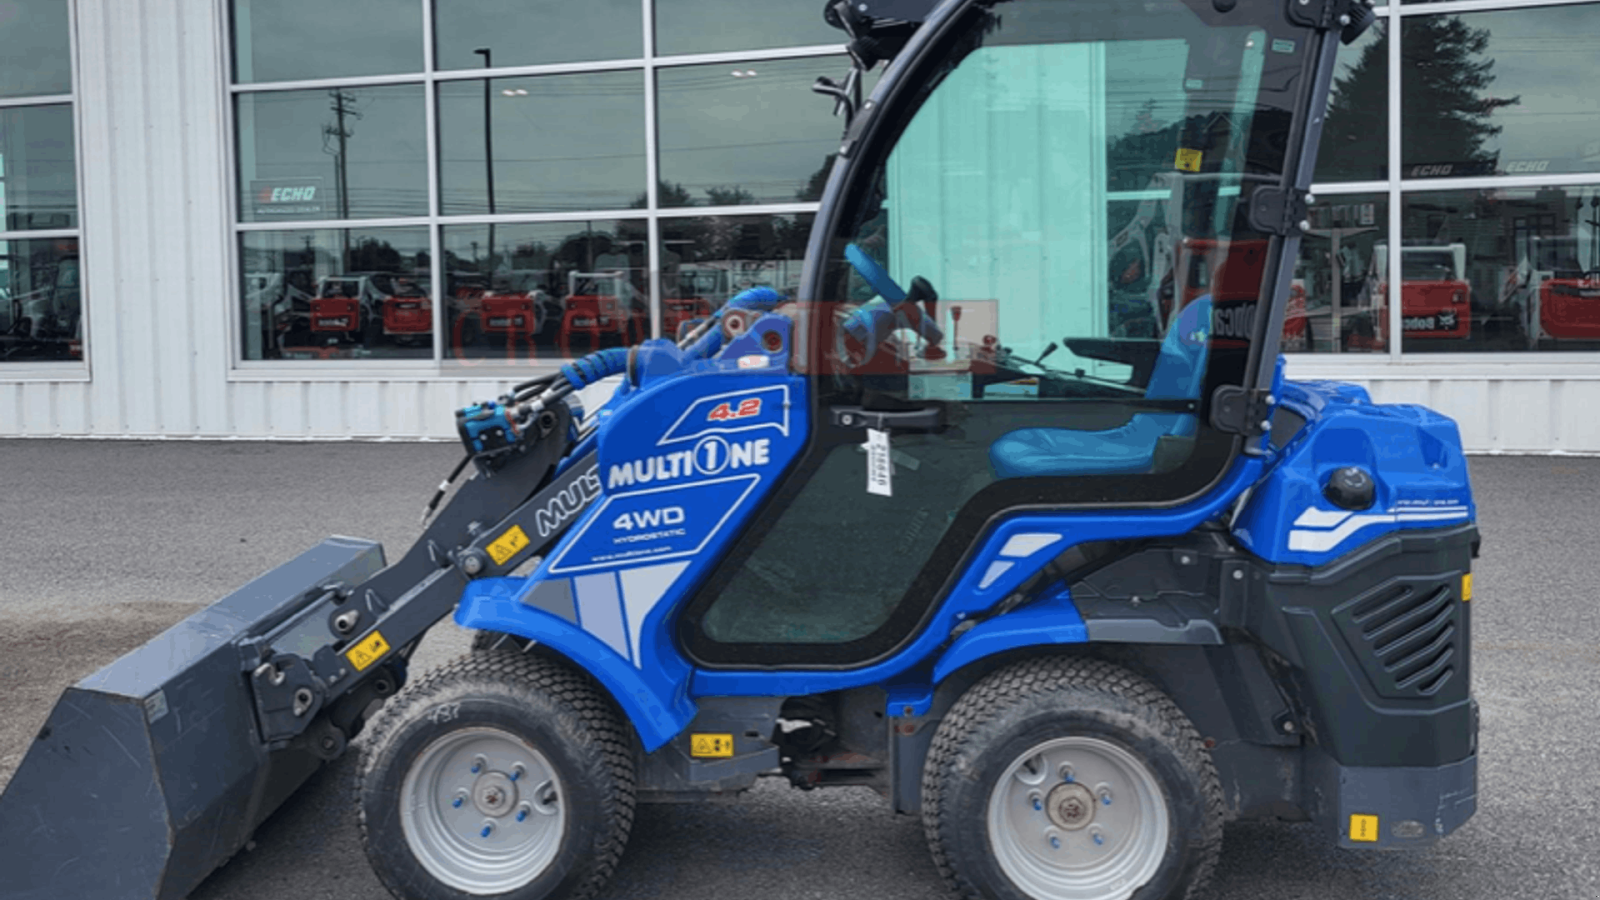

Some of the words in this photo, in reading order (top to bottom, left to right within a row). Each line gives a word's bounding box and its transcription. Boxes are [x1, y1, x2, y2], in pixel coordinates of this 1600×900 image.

[1411, 164, 1453, 177] ECHO
[1506, 160, 1549, 173] ECHO
[271, 186, 316, 202] ECHO
[706, 398, 762, 421] 4.2
[612, 506, 686, 531] 4WD
[612, 527, 687, 545] HYDROSTATIC
